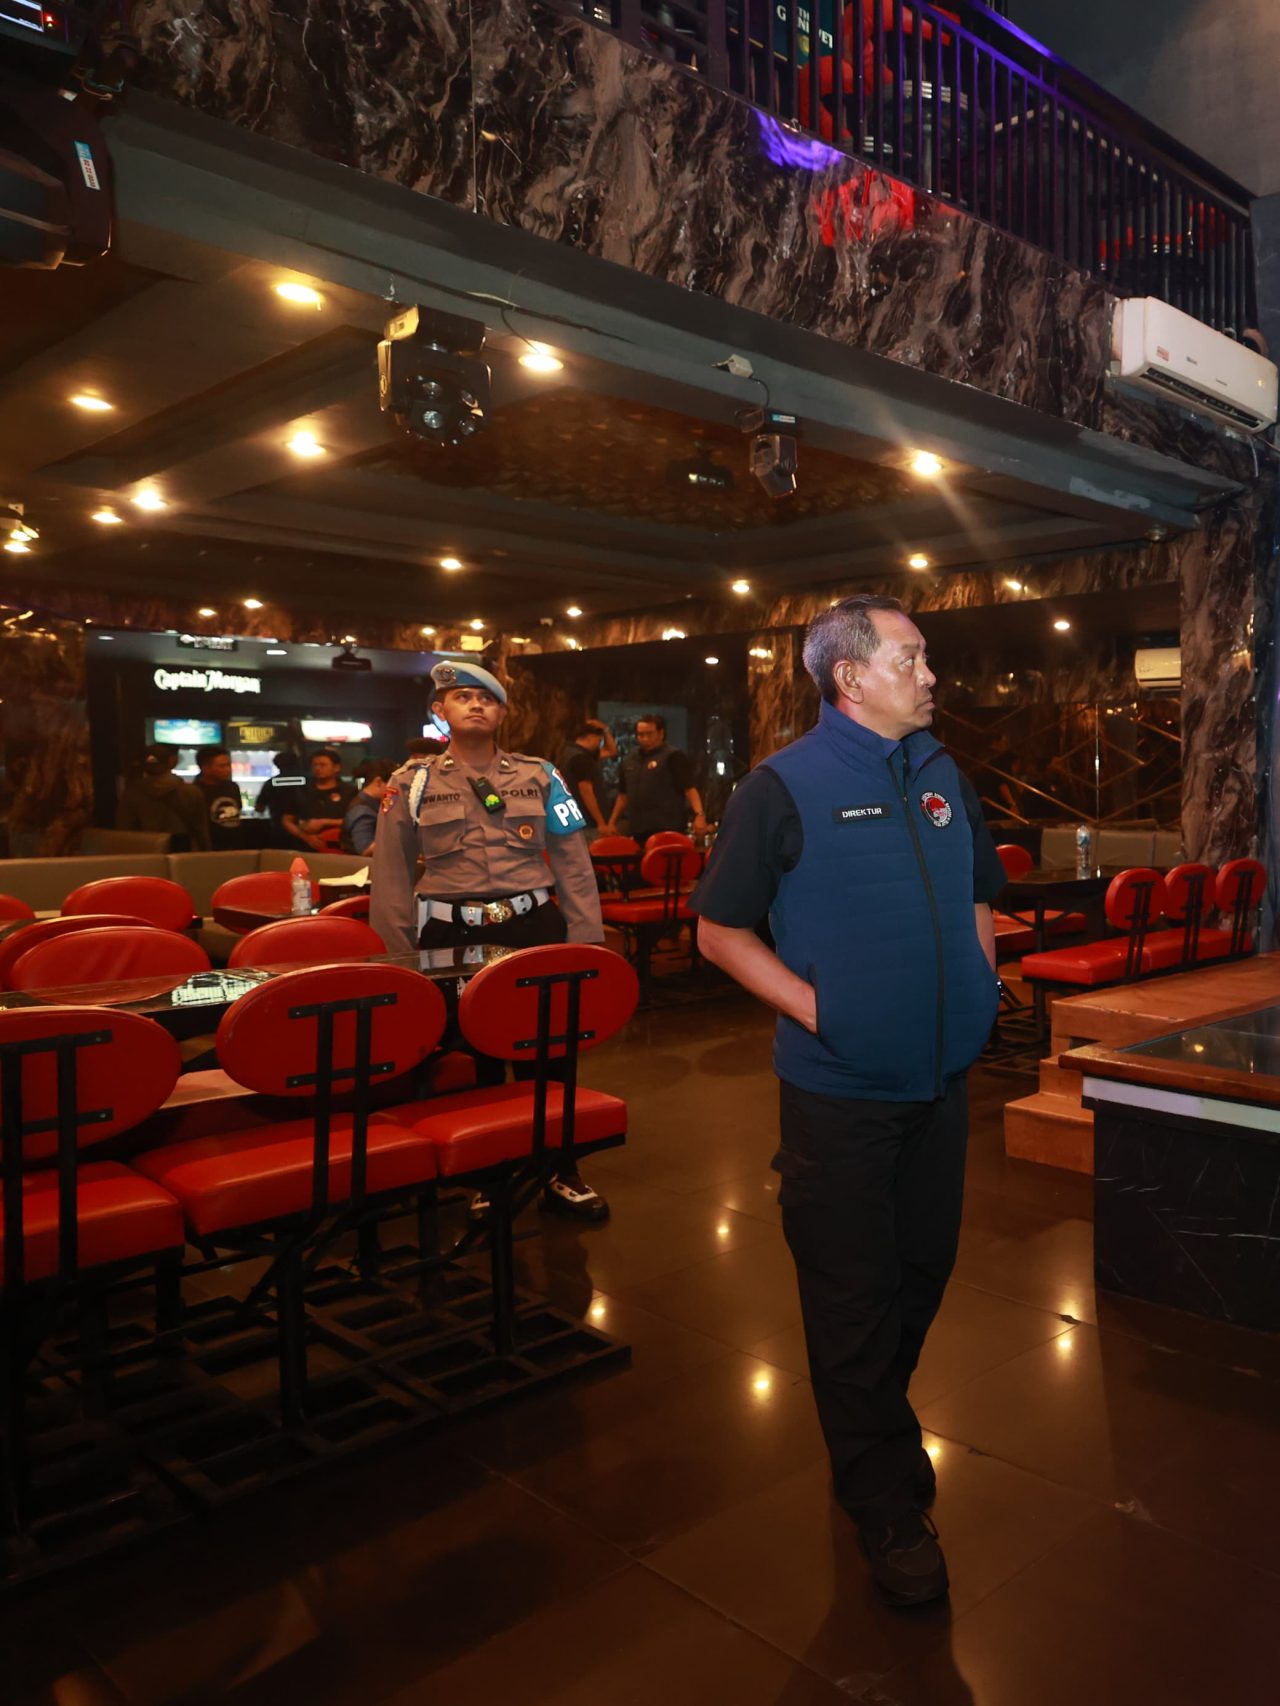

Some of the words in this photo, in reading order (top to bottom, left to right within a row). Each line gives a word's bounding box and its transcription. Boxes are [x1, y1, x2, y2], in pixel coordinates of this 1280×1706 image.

[154, 668, 207, 691] Captain
[204, 669, 262, 693] Morgan
[501, 788, 539, 799] POLRI
[841, 807, 883, 819] DIREKTUR
